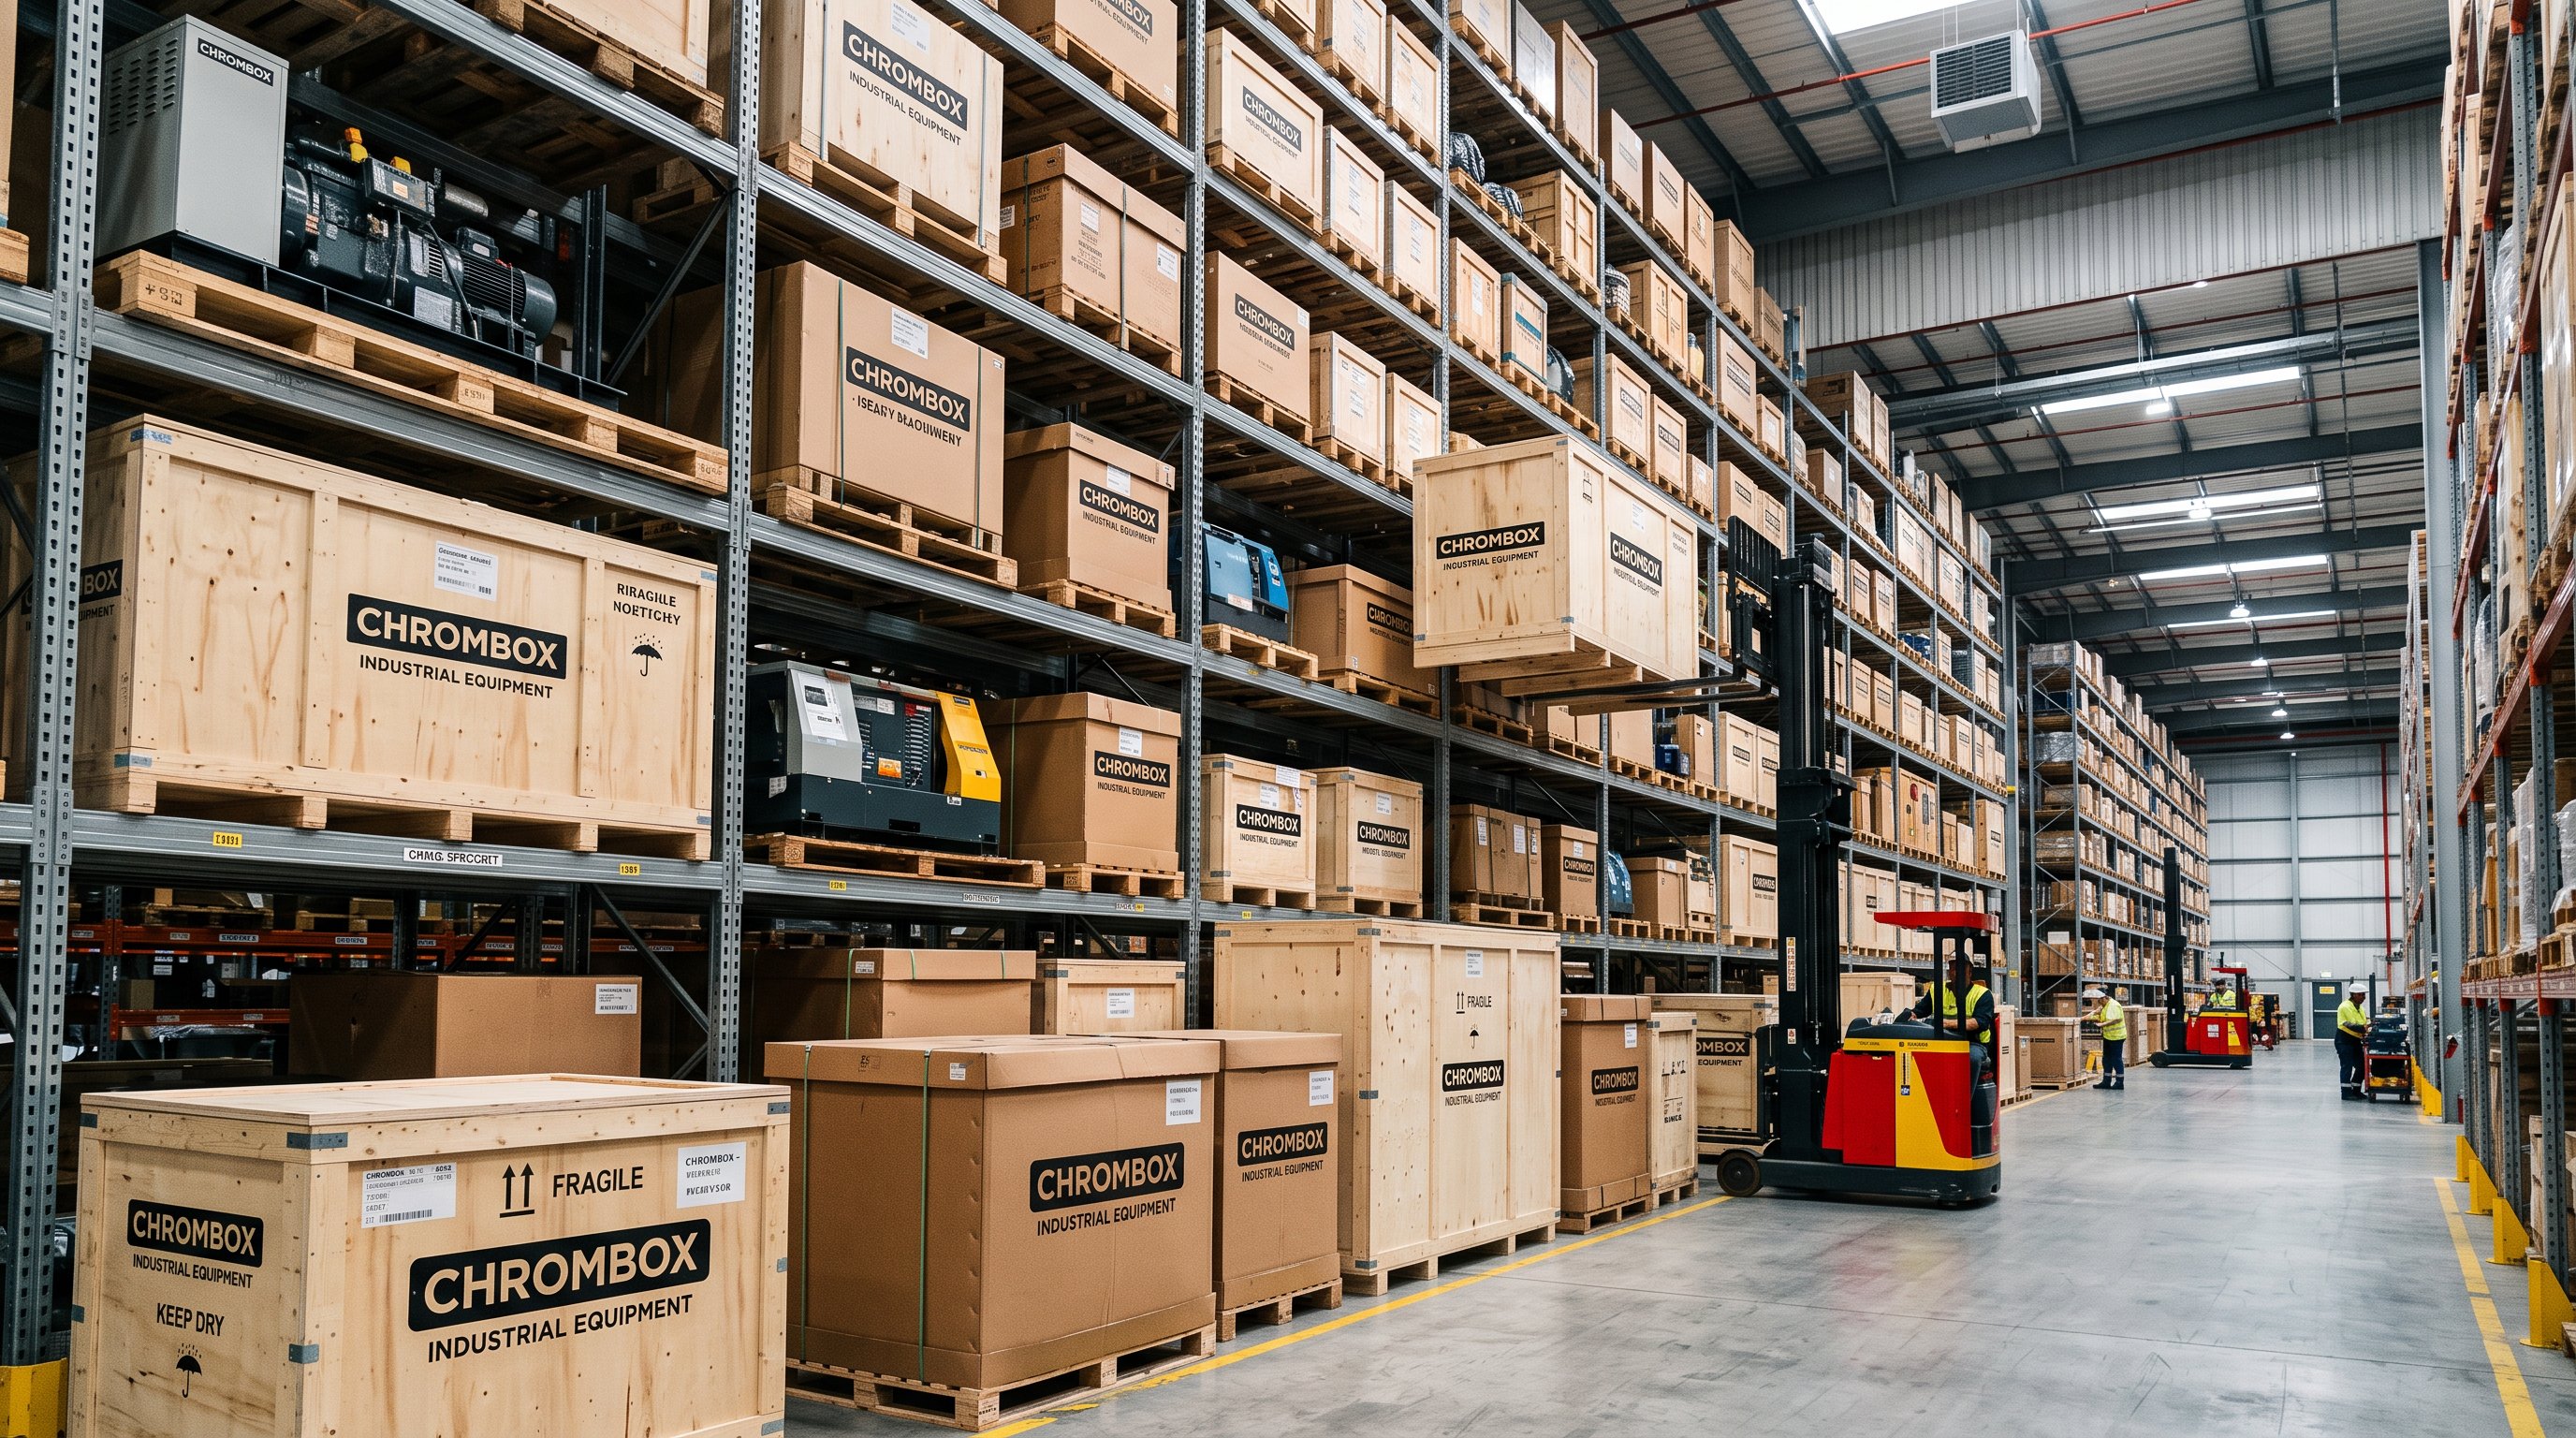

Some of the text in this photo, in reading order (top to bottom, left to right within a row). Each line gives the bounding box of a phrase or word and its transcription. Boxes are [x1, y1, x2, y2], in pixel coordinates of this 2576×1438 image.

[199, 42, 271, 83] CHROMBOX
[848, 34, 963, 122] CHROMBOX
[849, 70, 961, 146] INDUSTRIAL EQUIPMENT
[1237, 300, 1293, 345] CHROMBOX
[851, 357, 965, 423] CHROMBOX
[1082, 486, 1156, 528] CHROMBOX
[1440, 526, 1540, 554] CHROMBOX
[357, 607, 558, 670] CHROMBOX
[359, 654, 553, 698] INDUSTRIAL EQUIPMENT
[1097, 756, 1167, 783] CHROMBOX
[1238, 810, 1298, 832] CHROMBOX
[1359, 825, 1408, 845] CHROMBOX
[1467, 995, 1492, 1008] FRAGILE
[1696, 1041, 1746, 1053] OMBOX
[1444, 1065, 1501, 1087] CHROMBOX
[685, 1153, 735, 1167] CHROMBOX
[1241, 1128, 1324, 1159] CHROMBOX
[552, 1166, 644, 1198] FRAGILE
[1037, 1152, 1178, 1201] CHROMBOX
[133, 1210, 256, 1256] CHROMBOX
[1036, 1197, 1177, 1237] INDUSTRIAL EQUIPMENT
[133, 1253, 254, 1289] INDUSTRIAL EQUIPMENT
[424, 1231, 698, 1314] CHROMBOX
[156, 1302, 225, 1337] KEEP DRY
[428, 1294, 694, 1363] INDUSTRIAL EQUIPMENT
